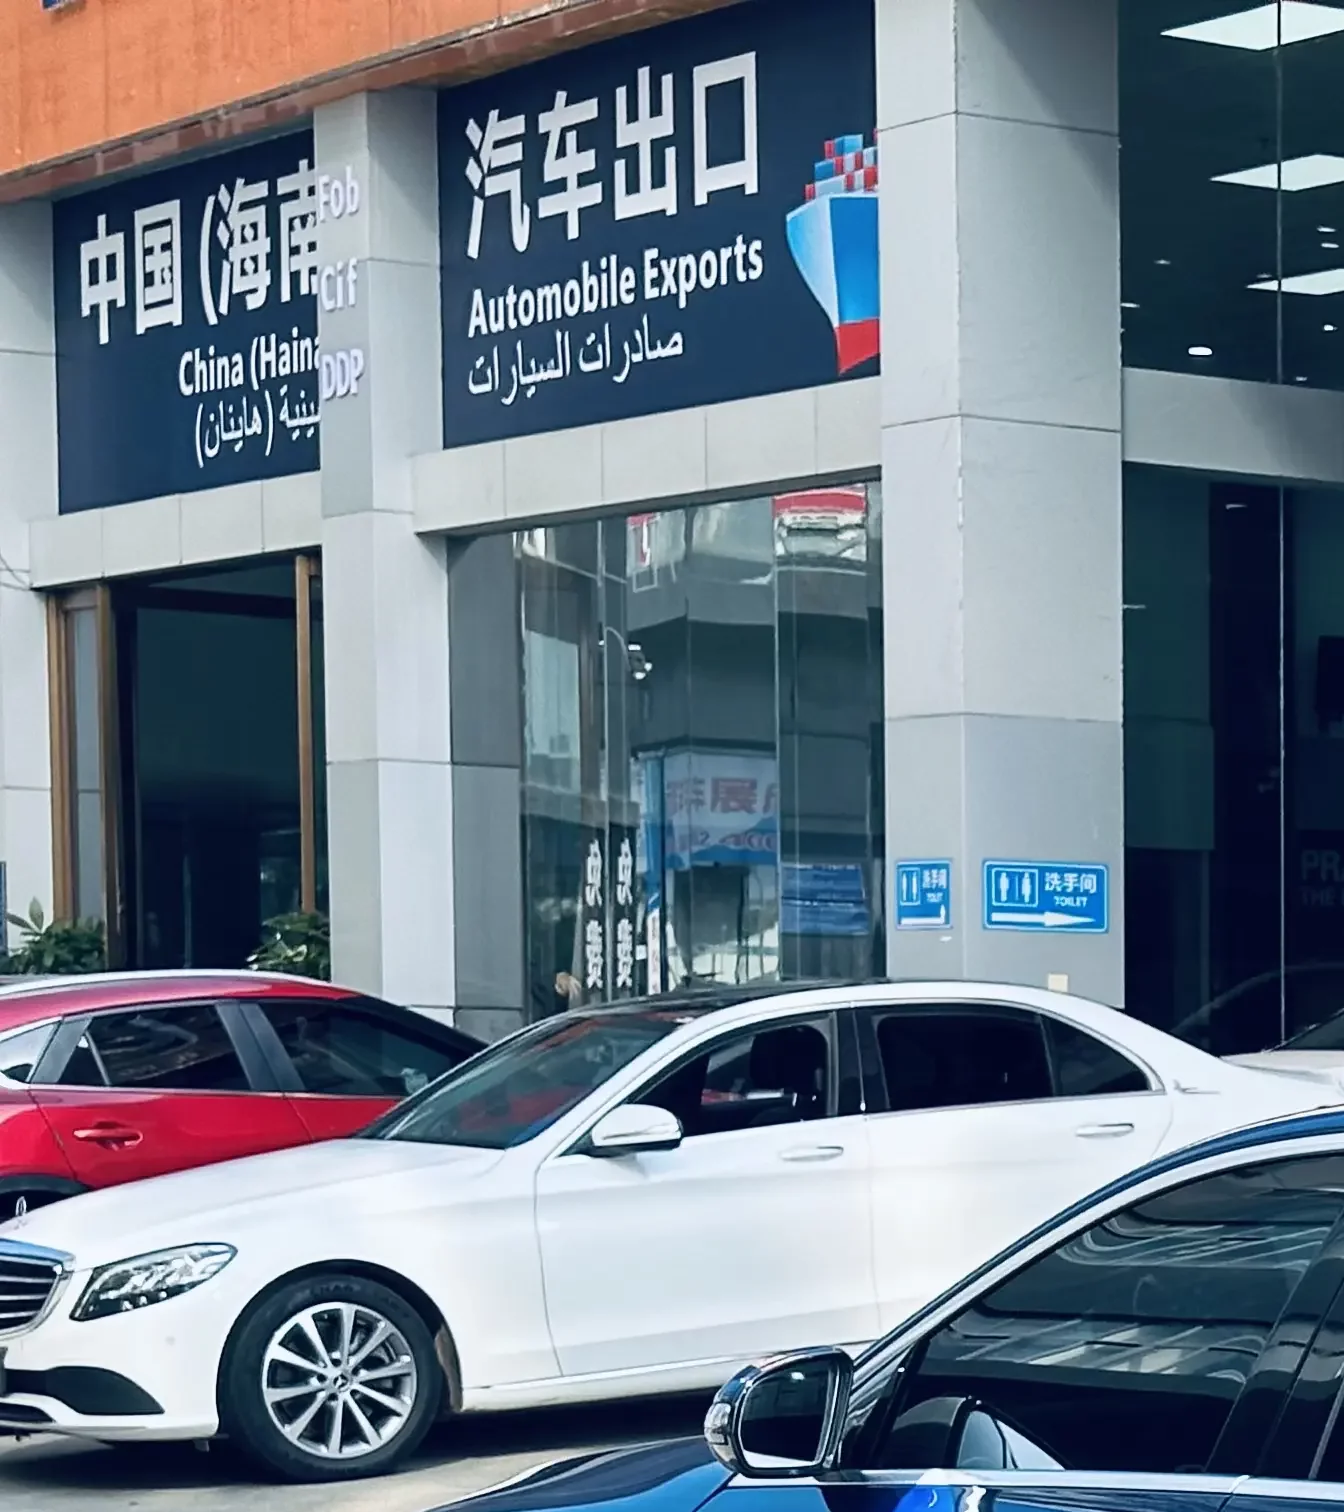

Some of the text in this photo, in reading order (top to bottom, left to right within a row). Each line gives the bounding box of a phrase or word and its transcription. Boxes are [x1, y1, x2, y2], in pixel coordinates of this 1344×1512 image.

[464, 51, 759, 260] 汽车出口
[318, 165, 359, 223] Fob
[320, 257, 358, 312] Cif
[468, 234, 764, 339] Automobile Exports
[178, 345, 244, 397] China
[321, 348, 364, 401] DDP
[467, 313, 684, 406] صادرات السيارات
[1044, 872, 1097, 894] 洗手间
